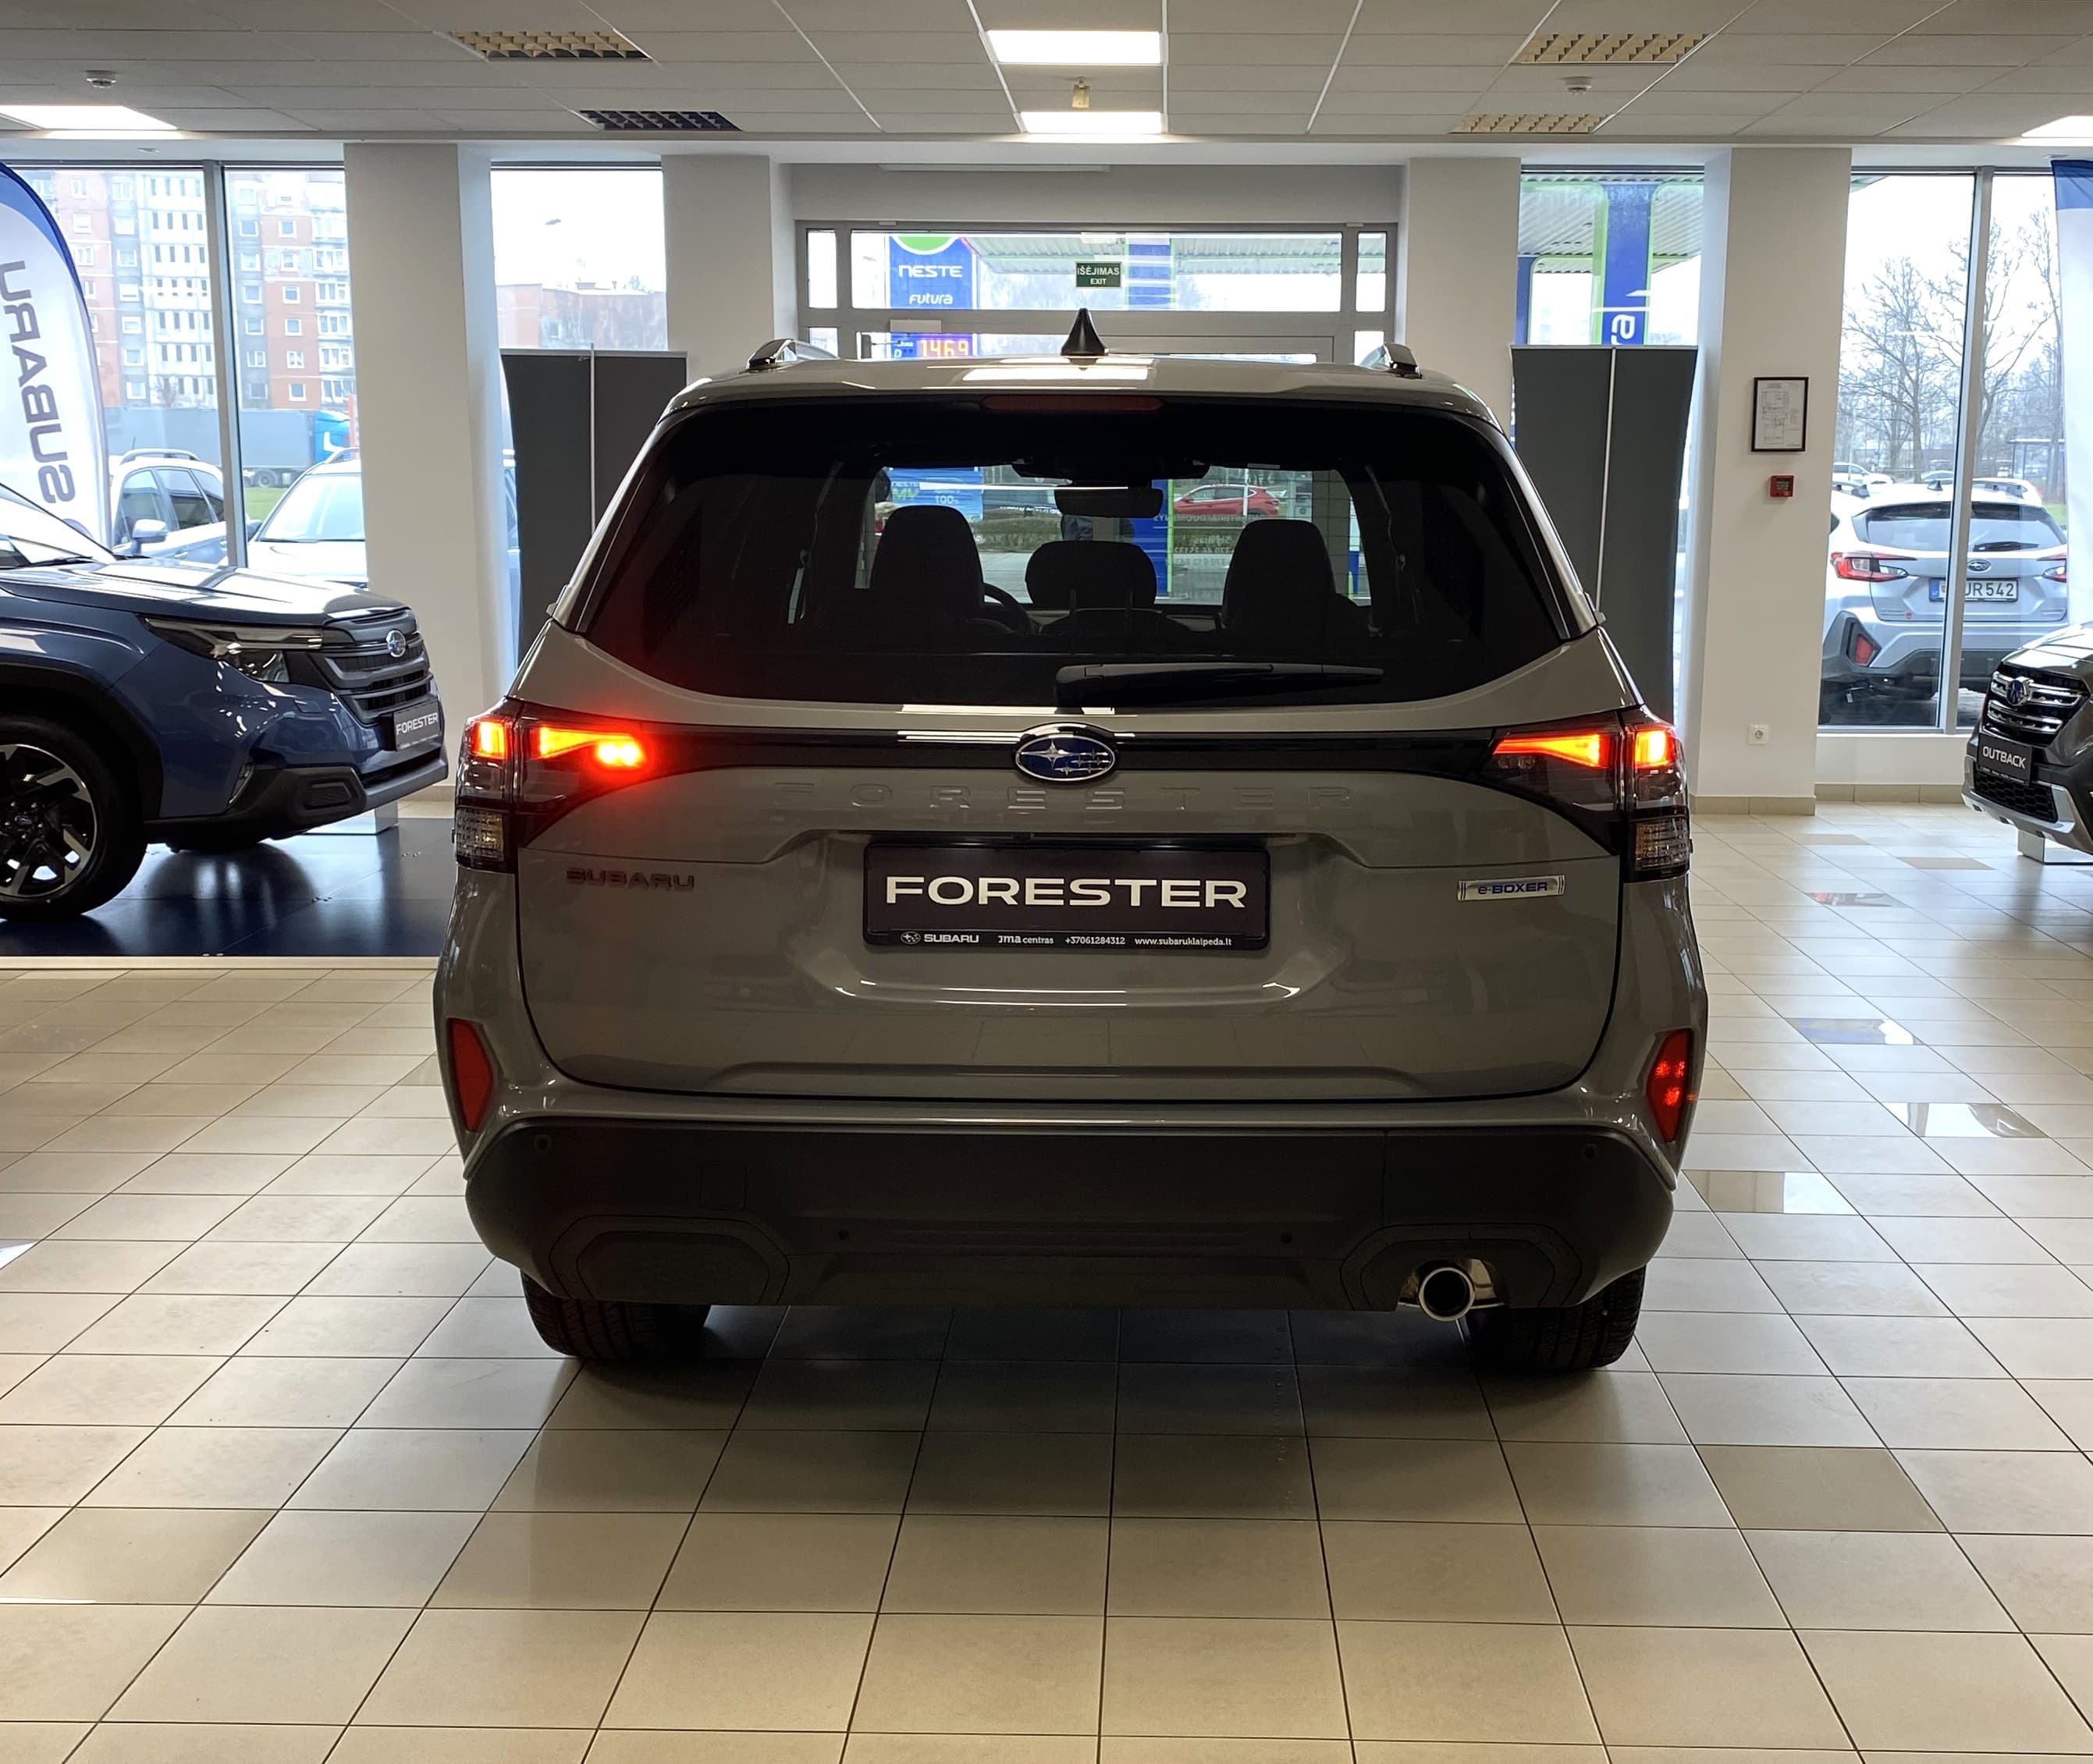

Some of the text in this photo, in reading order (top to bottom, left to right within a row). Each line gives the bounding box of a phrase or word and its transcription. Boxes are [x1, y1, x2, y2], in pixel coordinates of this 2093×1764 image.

[898, 264, 963, 278] NESTE
[396, 712, 439, 736] FORESTER
[1982, 746, 2026, 769] OUTBACK
[566, 867, 695, 889] SUBARU
[1477, 882, 1548, 895] e-BOXER
[887, 876, 1246, 908] FORESTER
[923, 933, 979, 943] SUBARU
[1022, 936, 1054, 945] centras
[1065, 936, 1126, 946] +37061284312
[1135, 937, 1232, 947] www.subaruklaipeda.lt
